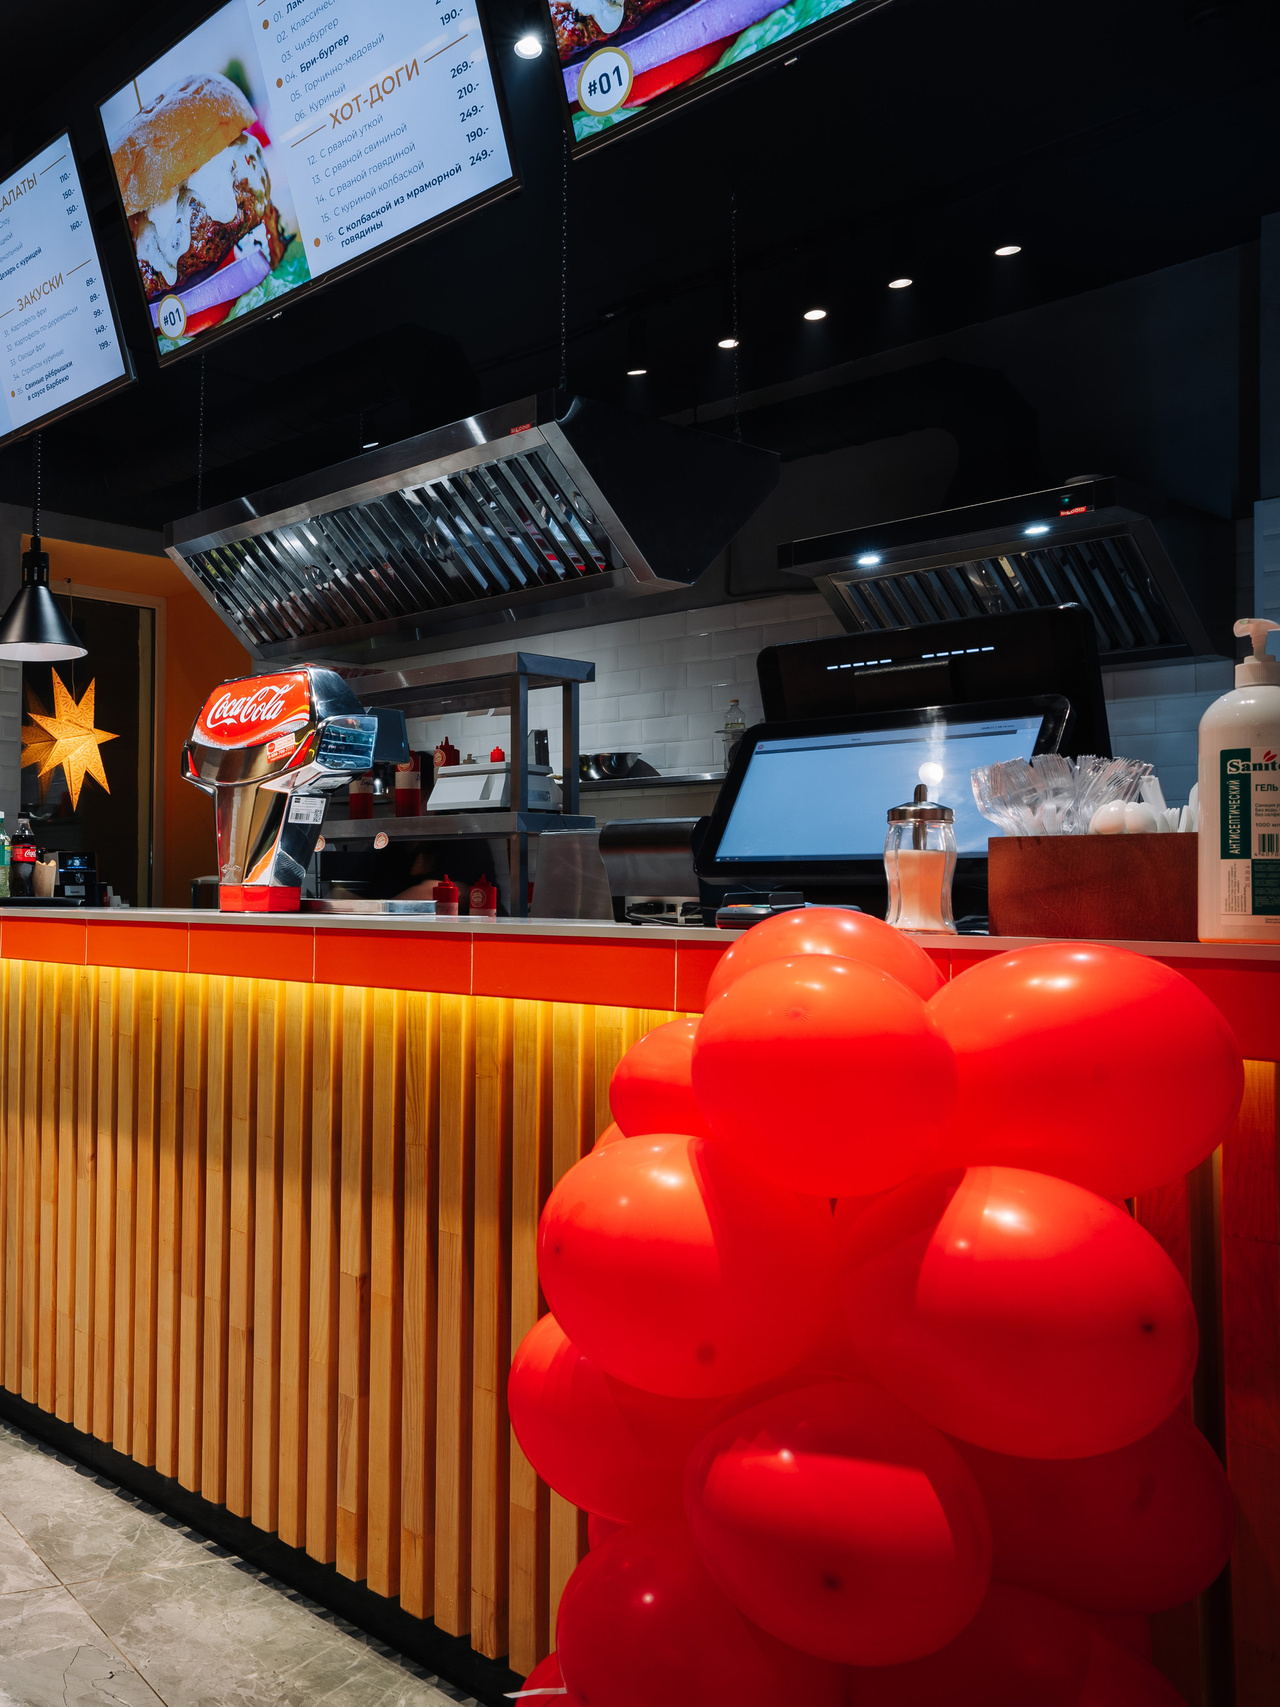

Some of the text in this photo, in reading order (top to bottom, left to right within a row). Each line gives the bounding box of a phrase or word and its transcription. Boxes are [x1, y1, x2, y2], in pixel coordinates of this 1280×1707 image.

[273, 11, 284, 22] 01.
[440, 8, 463, 26] 190.-
[276, 31, 288, 43] 02.
[281, 18, 339, 63] 03. Чизбургер
[285, 34, 349, 83] 04. Бри-бургер
[290, 32, 385, 102] 05. Горчично-медовый
[450, 60, 475, 78] 269.-
[587, 65, 624, 97] #01
[329, 58, 419, 129] ХОТ-ДОГИ
[457, 83, 480, 99] 210.-
[295, 82, 347, 122] 06. Куриный
[460, 104, 484, 122] 249.-
[308, 114, 384, 166] 12. С рваной уткой
[466, 127, 489, 143] 190.-
[312, 122, 408, 184] 13. С рваной свининой
[469, 149, 494, 166] 249.-
[316, 141, 416, 205] 14. С рваной говядиной
[63, 189, 75, 200] 150.-
[321, 160, 425, 223] 15. С куриной колбаской
[66, 205, 79, 215] 150.-
[325, 162, 462, 242] 16. С колбаской из мраморной
[70, 220, 82, 231] 160.-
[341, 221, 383, 248] говядины
[20, 246, 42, 266] курицей
[86, 277, 96, 286] 89.-
[17, 273, 64, 312] ЗАКУСКИ
[90, 293, 100, 302] 89.-
[11, 314, 36, 333] Картофель
[36, 307, 47, 319] фри
[93, 309, 104, 318] 99.-
[164, 308, 182, 326] #01
[14, 327, 40, 347] Картофель
[95, 325, 108, 335] 149.-
[35, 342, 46, 353] фри
[99, 340, 111, 350] 199.-
[25, 375, 44, 390] Свиные
[32, 387, 45, 399] соусе
[46, 375, 69, 391] Барбекю
[1227, 780, 1240, 854] АНТИСЕПТИЧЕСКИЙ
